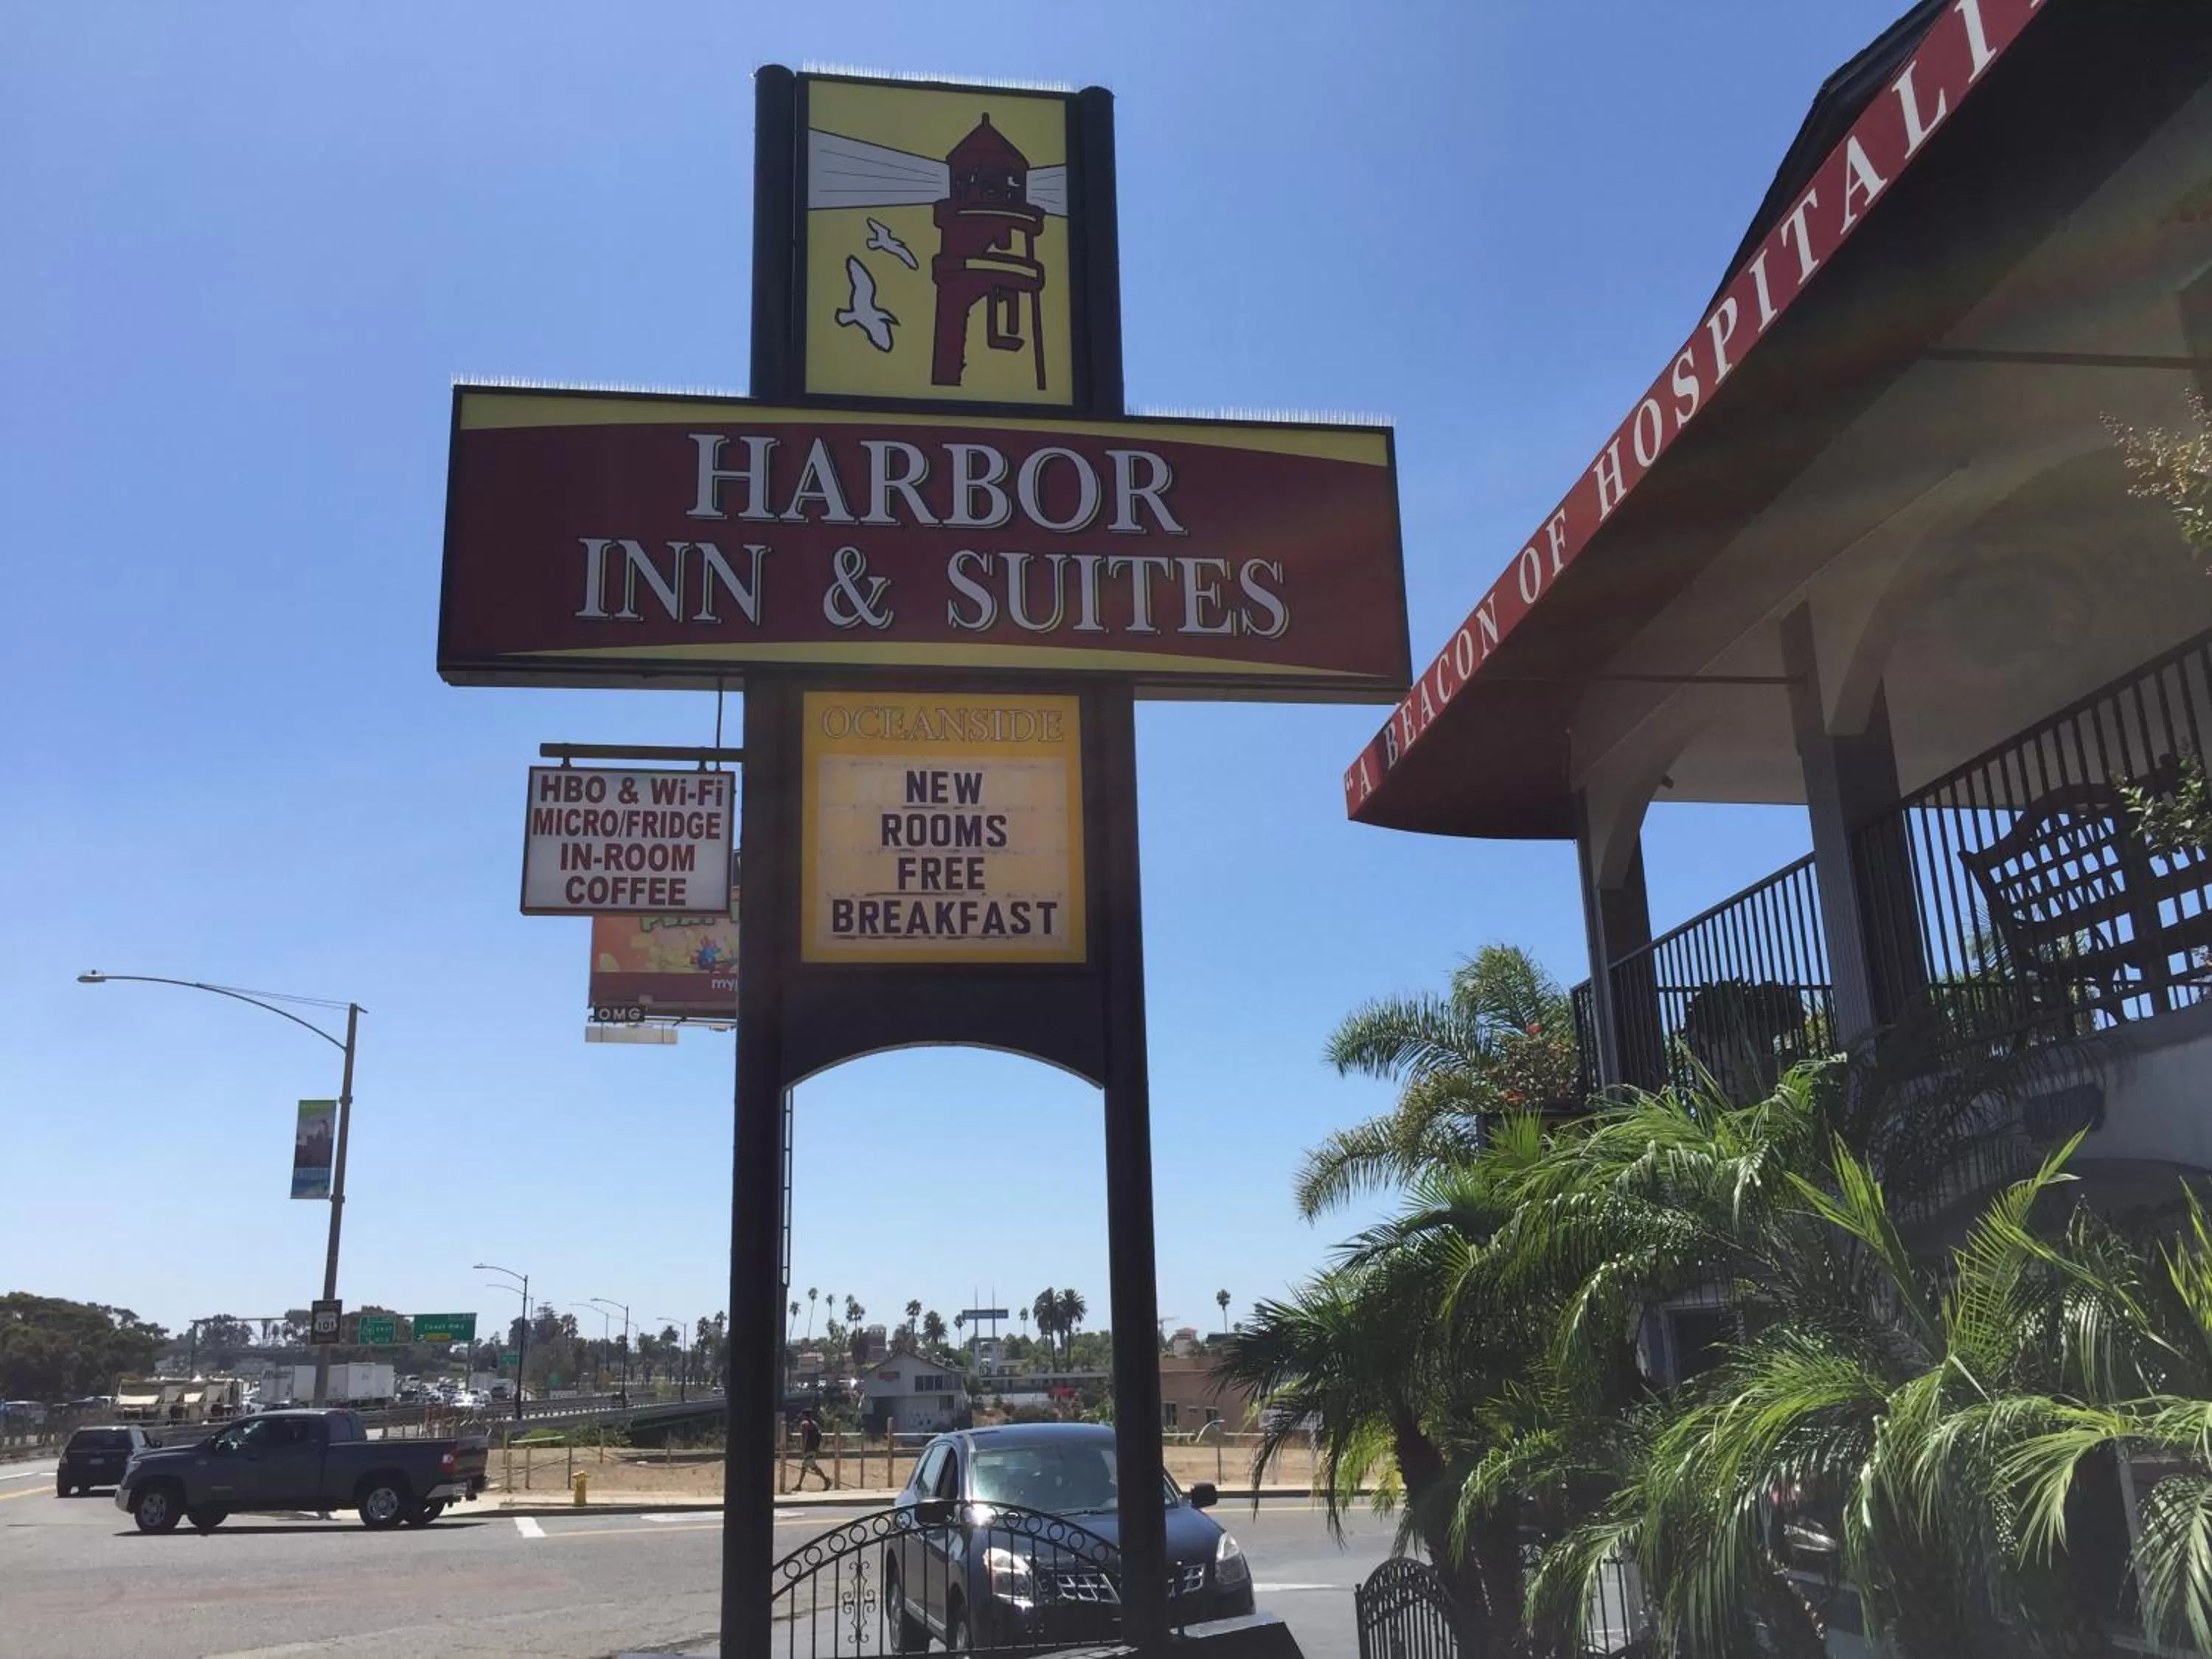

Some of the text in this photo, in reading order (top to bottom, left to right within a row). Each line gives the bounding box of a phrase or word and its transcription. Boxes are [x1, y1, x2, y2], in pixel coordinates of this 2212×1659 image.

[1383, 591, 1500, 770] BEACON
[1519, 508, 1567, 604] OF
[1593, 0, 2041, 521] HOSPITALI
[686, 433, 1189, 535] HARBOR
[575, 537, 1290, 639] INN & SUITES
[820, 705, 1064, 742] OCEANSIDE
[540, 775, 723, 807] HBO & Wi-Fi
[906, 770, 983, 804] NEW
[532, 807, 722, 840] MICRO/FRIDGE
[881, 813, 1007, 847] ROOMS
[560, 843, 695, 872] IN-ROOM
[897, 857, 986, 891] FREE
[566, 875, 686, 906] COFFEE
[832, 899, 1058, 935] BREAKFAST
[712, 978, 738, 992] my
[598, 1007, 641, 1020] OMG
[318, 1321, 335, 1332] 101
